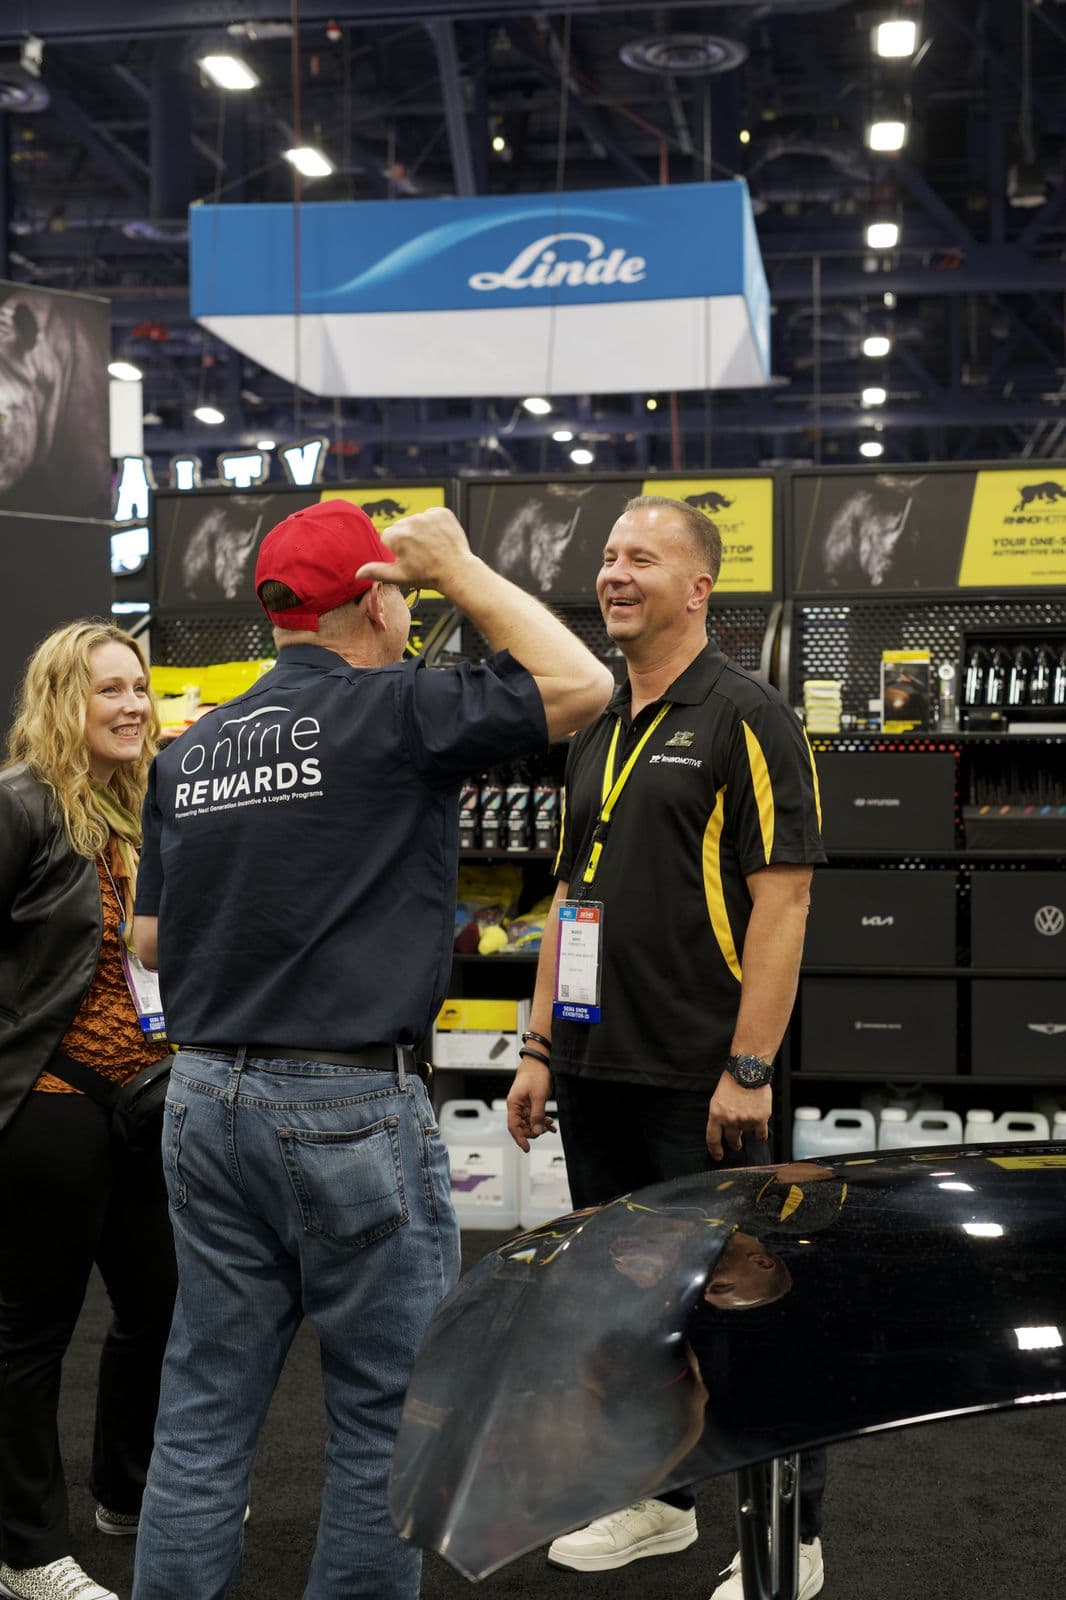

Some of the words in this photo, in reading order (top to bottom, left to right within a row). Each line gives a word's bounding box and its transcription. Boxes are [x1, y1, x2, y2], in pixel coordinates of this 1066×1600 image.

[468, 232, 647, 291] Linde
[181, 716, 320, 775] online
[175, 757, 322, 808] REWARDS
[268, 793, 291, 805] Loyalty
[291, 790, 324, 801] Programs
